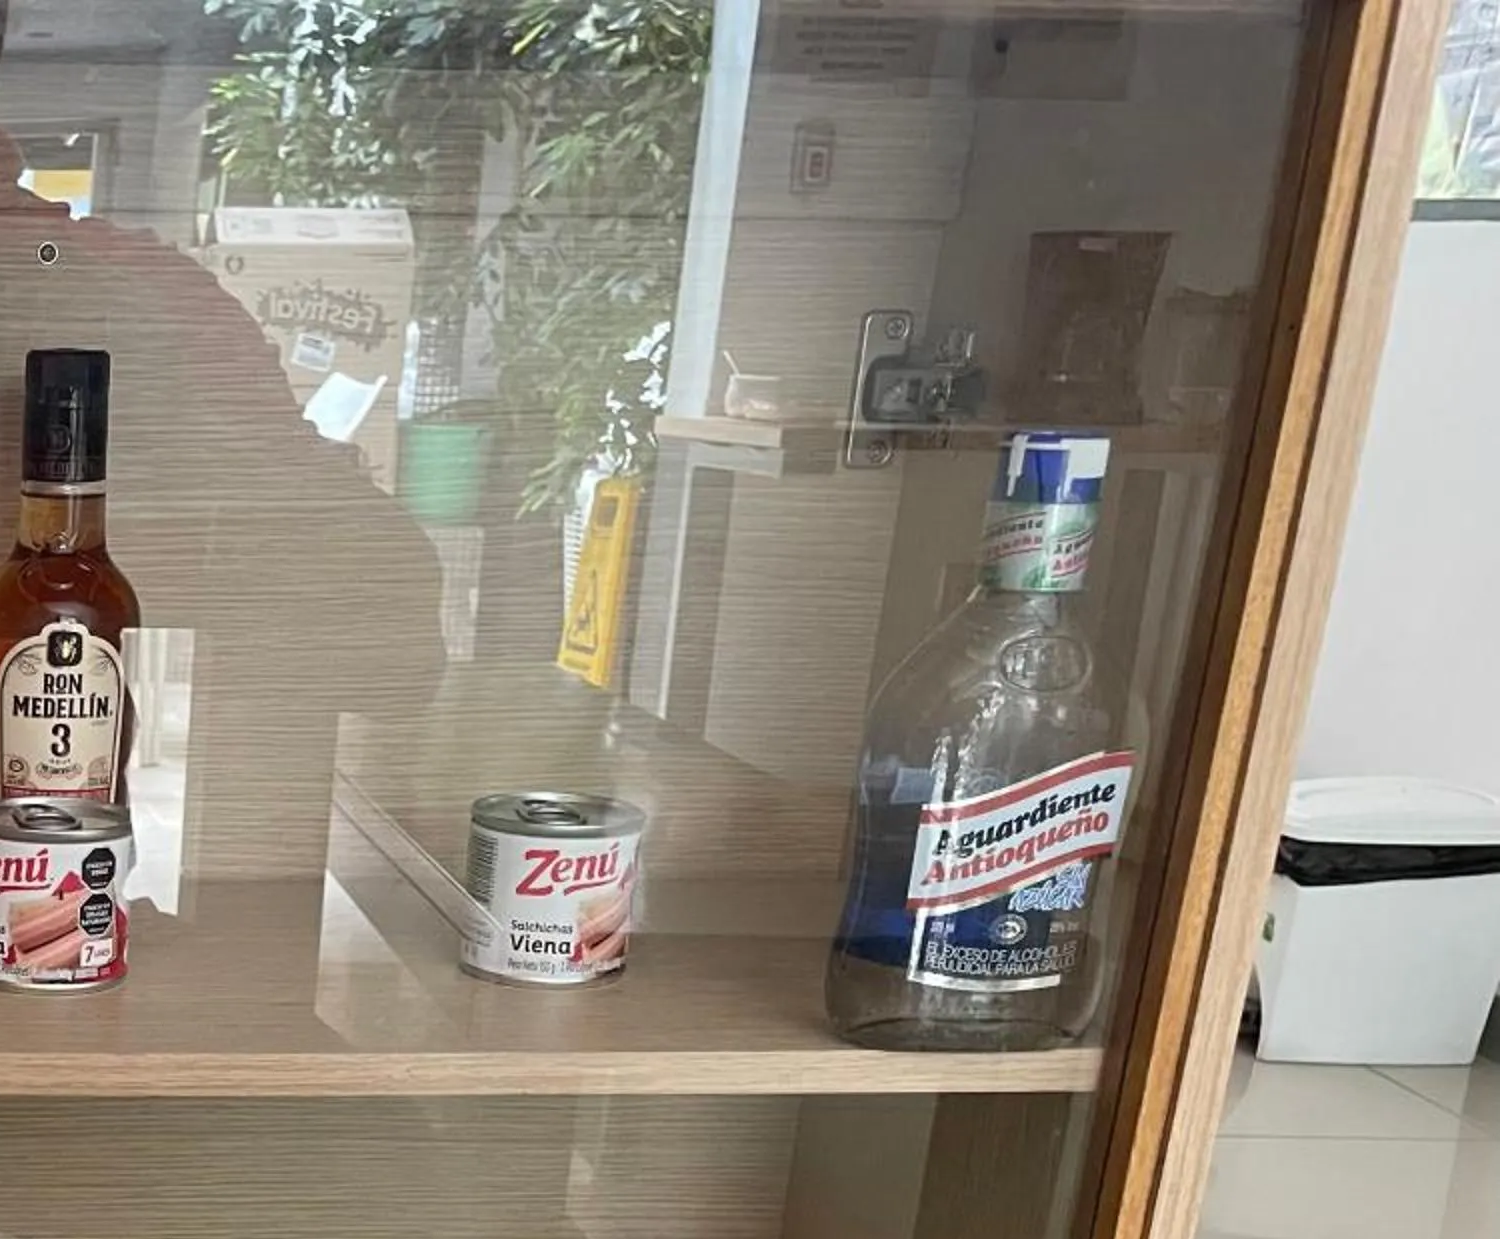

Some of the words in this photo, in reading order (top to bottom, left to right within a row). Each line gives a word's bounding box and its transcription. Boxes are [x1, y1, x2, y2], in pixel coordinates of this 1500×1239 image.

[43, 673, 83, 695] RON
[12, 691, 110, 719] MEDELLÍN
[51, 723, 71, 758] 3
[932, 781, 1117, 859] Aguardiente
[920, 808, 1110, 887] Antioqueño
[515, 840, 621, 897] Zenú
[510, 919, 574, 935] Salchichas
[84, 945, 95, 963] 7
[509, 932, 572, 955] Viena
